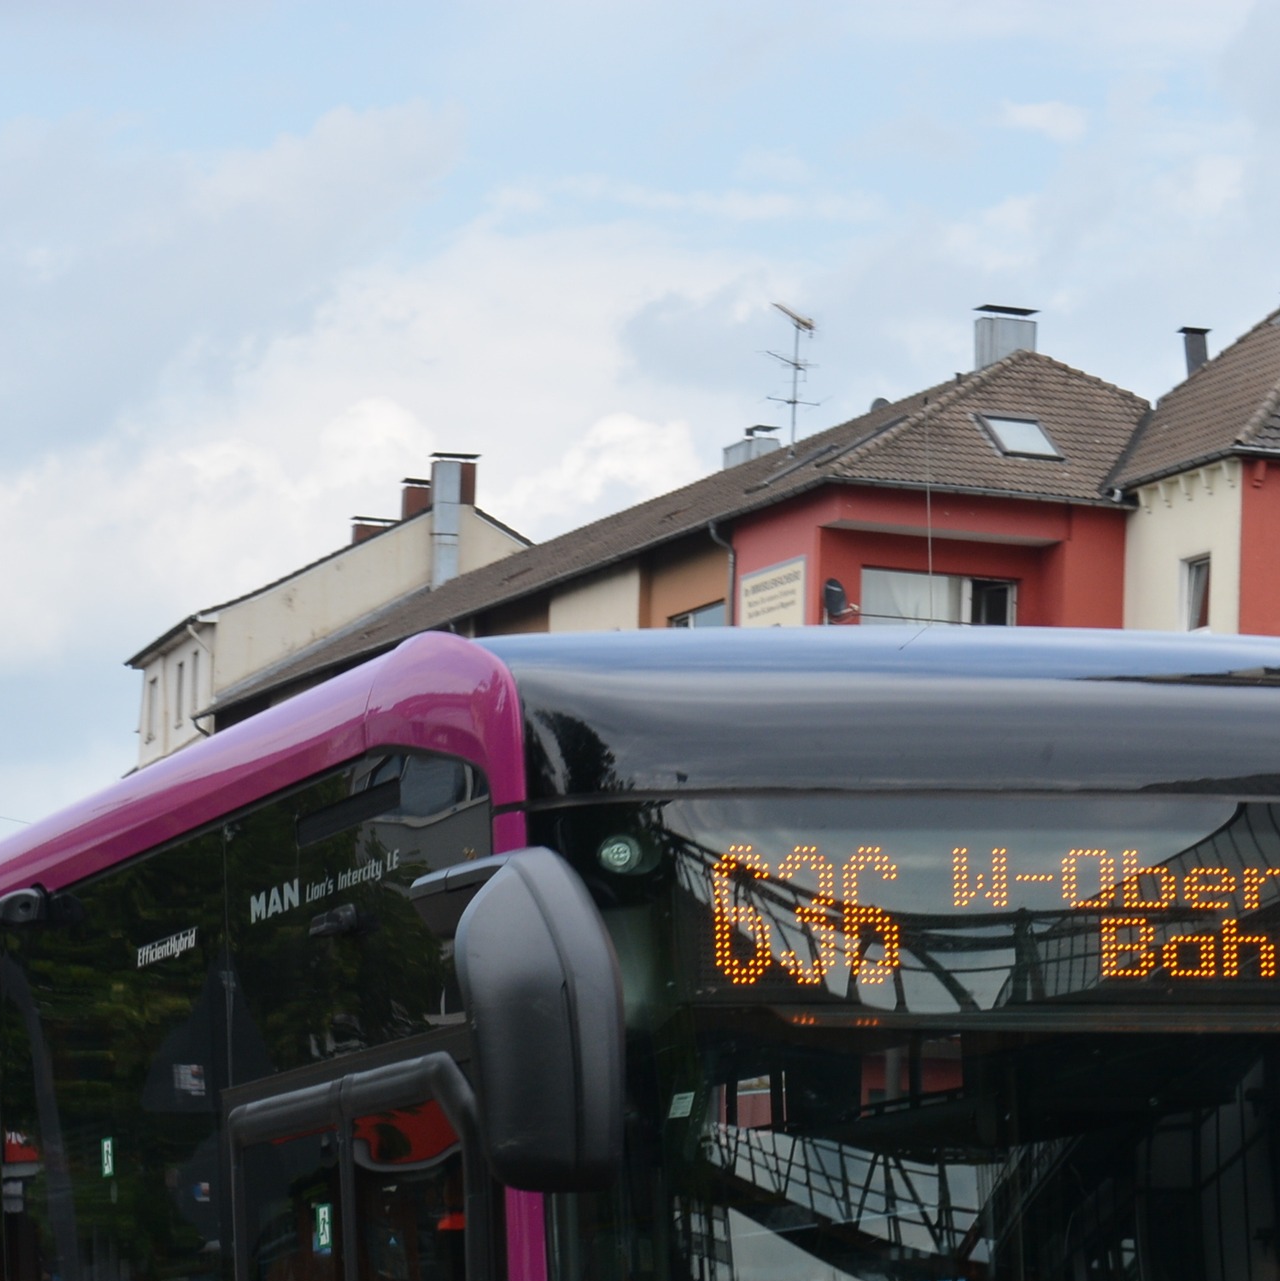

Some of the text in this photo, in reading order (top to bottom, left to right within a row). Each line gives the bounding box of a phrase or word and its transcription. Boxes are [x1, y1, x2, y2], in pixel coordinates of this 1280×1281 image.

[250, 849, 400, 924] MAN Lion's Intercity LE
[713, 845, 899, 984] 636
[137, 927, 197, 968] EfficientHybrid
